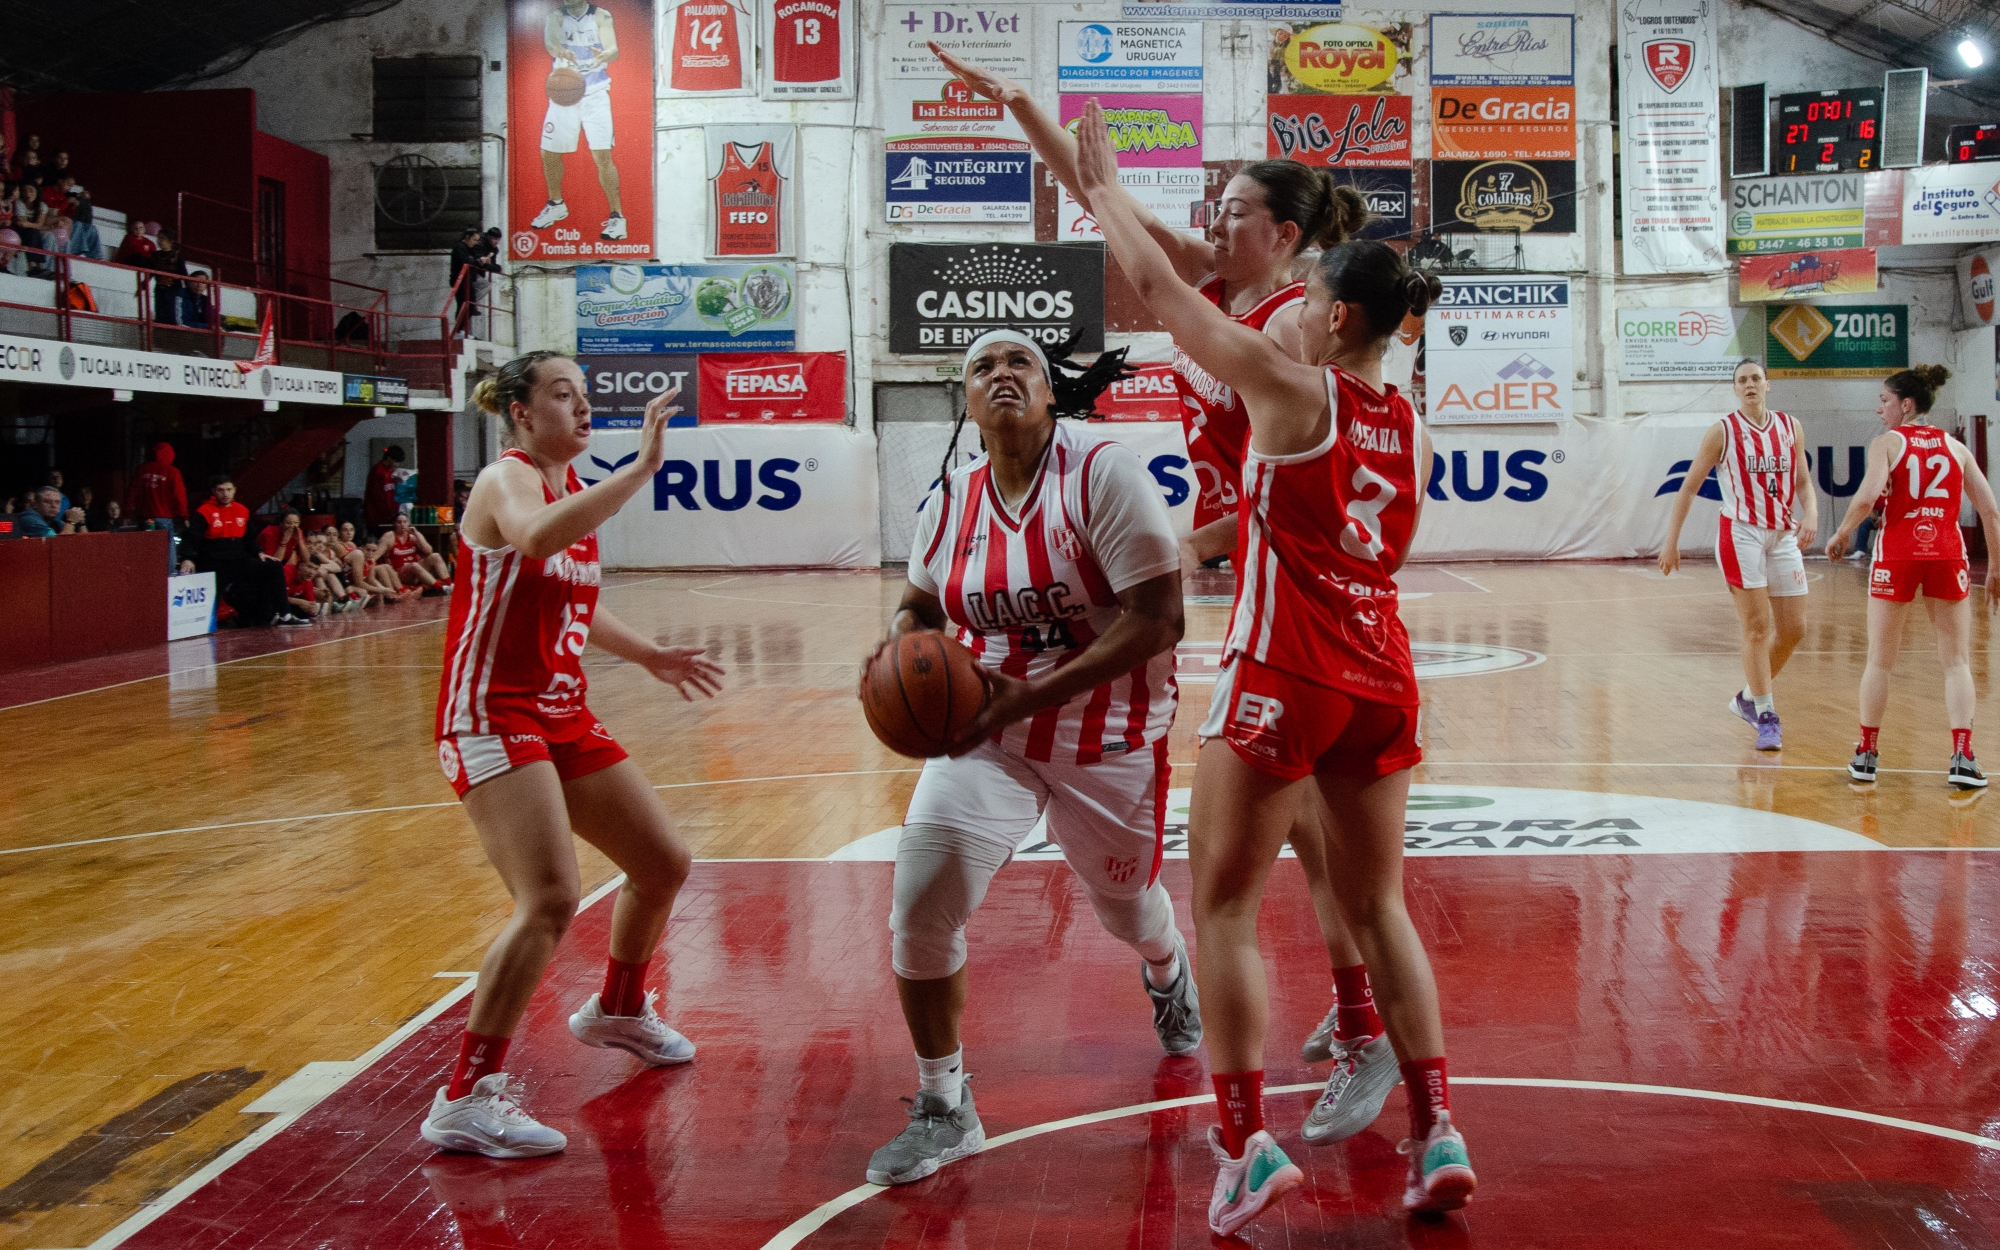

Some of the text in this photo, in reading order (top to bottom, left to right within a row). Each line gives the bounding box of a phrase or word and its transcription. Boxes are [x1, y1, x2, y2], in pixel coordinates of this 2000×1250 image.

[684, 5, 728, 16] PALLADINO
[777, 2, 838, 19] ROCAMORA
[1123, 5, 1342, 19] www.termasconcepcion.com
[975, 11, 1020, 33] Vet
[690, 18, 723, 51] 14
[794, 18, 821, 45] 13
[1116, 27, 1186, 36] RESONANCIA
[962, 40, 1012, 49] Veterinario
[1120, 40, 1182, 49] MAGNETICA
[1126, 52, 1177, 61] URUGUAY
[1299, 41, 1385, 77] Royal
[1658, 45, 1680, 65] R
[1062, 69, 1200, 77] DIAGNOSTICO POR IMAGENES
[919, 106, 997, 117] La Estancia
[1807, 100, 1852, 122] 07:01
[921, 123, 995, 132] Sabemos de Carne
[1327, 97, 1406, 164] Lola
[1786, 119, 1875, 145] 27 16
[1534, 150, 1571, 158] 441399
[1790, 154, 1796, 171] 1
[1821, 142, 1835, 163] 2
[1859, 149, 1871, 168] 2
[1960, 145, 1970, 161] 0
[934, 176, 986, 185] SEGUROS
[1117, 172, 1151, 184] artín
[1157, 171, 1200, 184] Fierro
[1498, 172, 1514, 191] 7
[1162, 187, 1200, 195] Instituto
[1478, 192, 1532, 206] COLINAS
[1734, 179, 1858, 209] SCHANTON
[1922, 186, 1975, 202] instituto
[729, 211, 768, 224] FEFO
[555, 228, 581, 241] Club
[1685, 225, 1713, 233] Argentina
[540, 242, 650, 255] Tomás de Rocamora
[1759, 236, 1845, 250] 3447 46 38 10
[1438, 285, 1559, 305] BANCHIK
[1971, 278, 1994, 300] Gulf
[581, 294, 682, 315] Parque Acuático
[916, 290, 1074, 319] CASINOS
[597, 308, 666, 325] Concepción
[1440, 310, 1557, 320] MULTIMARCAS
[1623, 321, 1703, 337] CORRER
[1834, 312, 1896, 338] zona
[919, 328, 945, 344] DE
[1502, 331, 1550, 340] HYUNDAI
[664, 340, 794, 349] www.termasconcepcion.com
[80, 357, 171, 381] TU CAJA A TIEMPO
[274, 376, 338, 394] TU CAJA A TIEMPO
[595, 371, 689, 394] SIGOT
[725, 374, 808, 393] FEPASA
[1112, 375, 1177, 394] FEPAS
[1435, 382, 1562, 412] AdER
[1909, 436, 1942, 449] SCHMIDT
[653, 457, 802, 512] RUS
[1905, 453, 1950, 500] 12
[1768, 478, 1778, 499] 4
[1921, 507, 1945, 519] RUS
[1873, 568, 1891, 584] ER
[186, 587, 206, 605] RUS
[554, 603, 590, 656] 15
[1019, 618, 1080, 654] 44
[1234, 691, 1284, 731] ER
